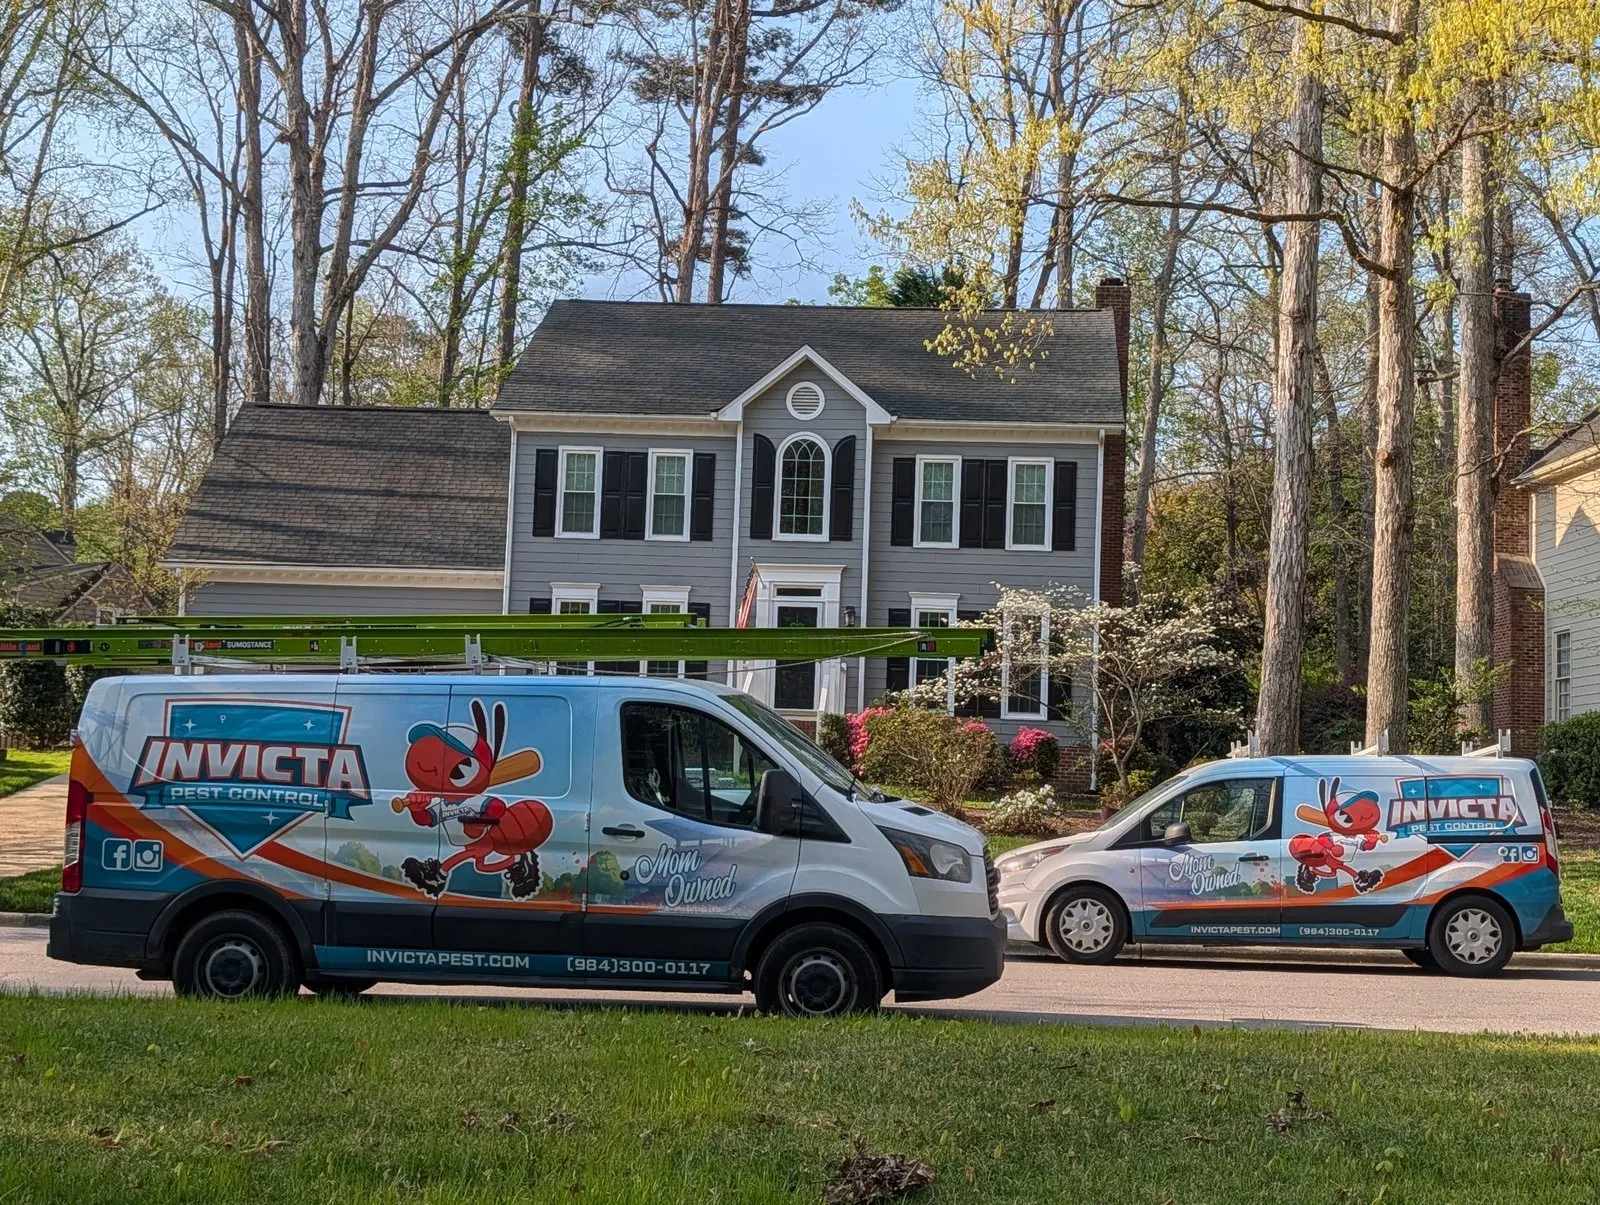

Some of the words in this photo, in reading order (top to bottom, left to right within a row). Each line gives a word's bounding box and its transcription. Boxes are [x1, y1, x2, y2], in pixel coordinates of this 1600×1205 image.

[226, 640, 273, 648] SUMOSTANCE
[136, 739, 370, 799] INVICTA
[170, 786, 223, 800] PEST
[227, 787, 324, 807] CONTROL
[441, 806, 471, 818] INVICTA
[1390, 797, 1525, 826] INVICTA
[1411, 823, 1441, 833] PEST
[1444, 821, 1498, 831] CONTROL
[634, 843, 702, 884] Mom
[1168, 853, 1216, 882] Mom
[664, 864, 738, 908] Owned
[1190, 863, 1241, 896] Owned
[1190, 926, 1281, 935] INVICTAPEST.COM
[1299, 926, 1380, 937] (984)300-0117
[366, 948, 531, 969] INVICTAPEST.COM
[566, 957, 712, 975] (984)300-0117
